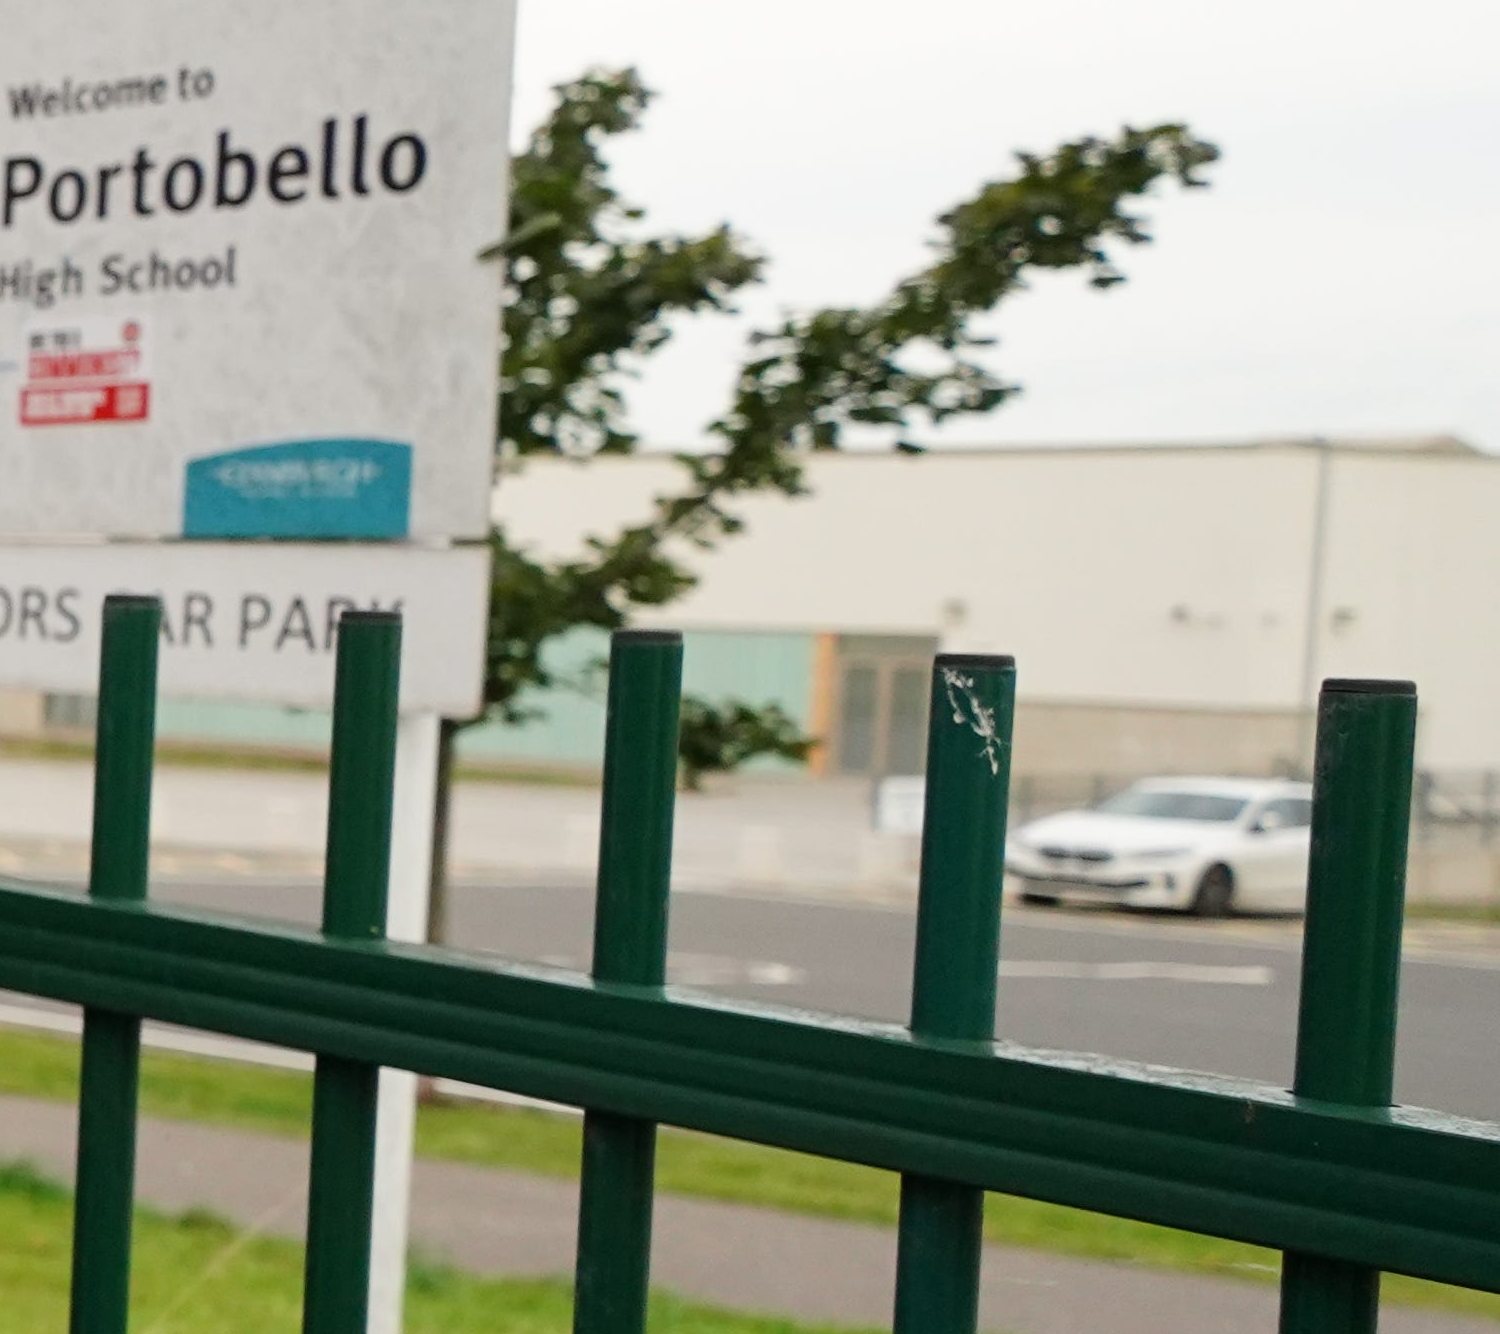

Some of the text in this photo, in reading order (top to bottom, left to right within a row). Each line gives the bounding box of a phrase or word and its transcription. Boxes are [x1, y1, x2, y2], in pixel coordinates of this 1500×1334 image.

[8, 67, 216, 120] Welcome to
[0, 113, 429, 230] Portobello
[101, 245, 238, 297] School
[239, 592, 405, 652] PAR
